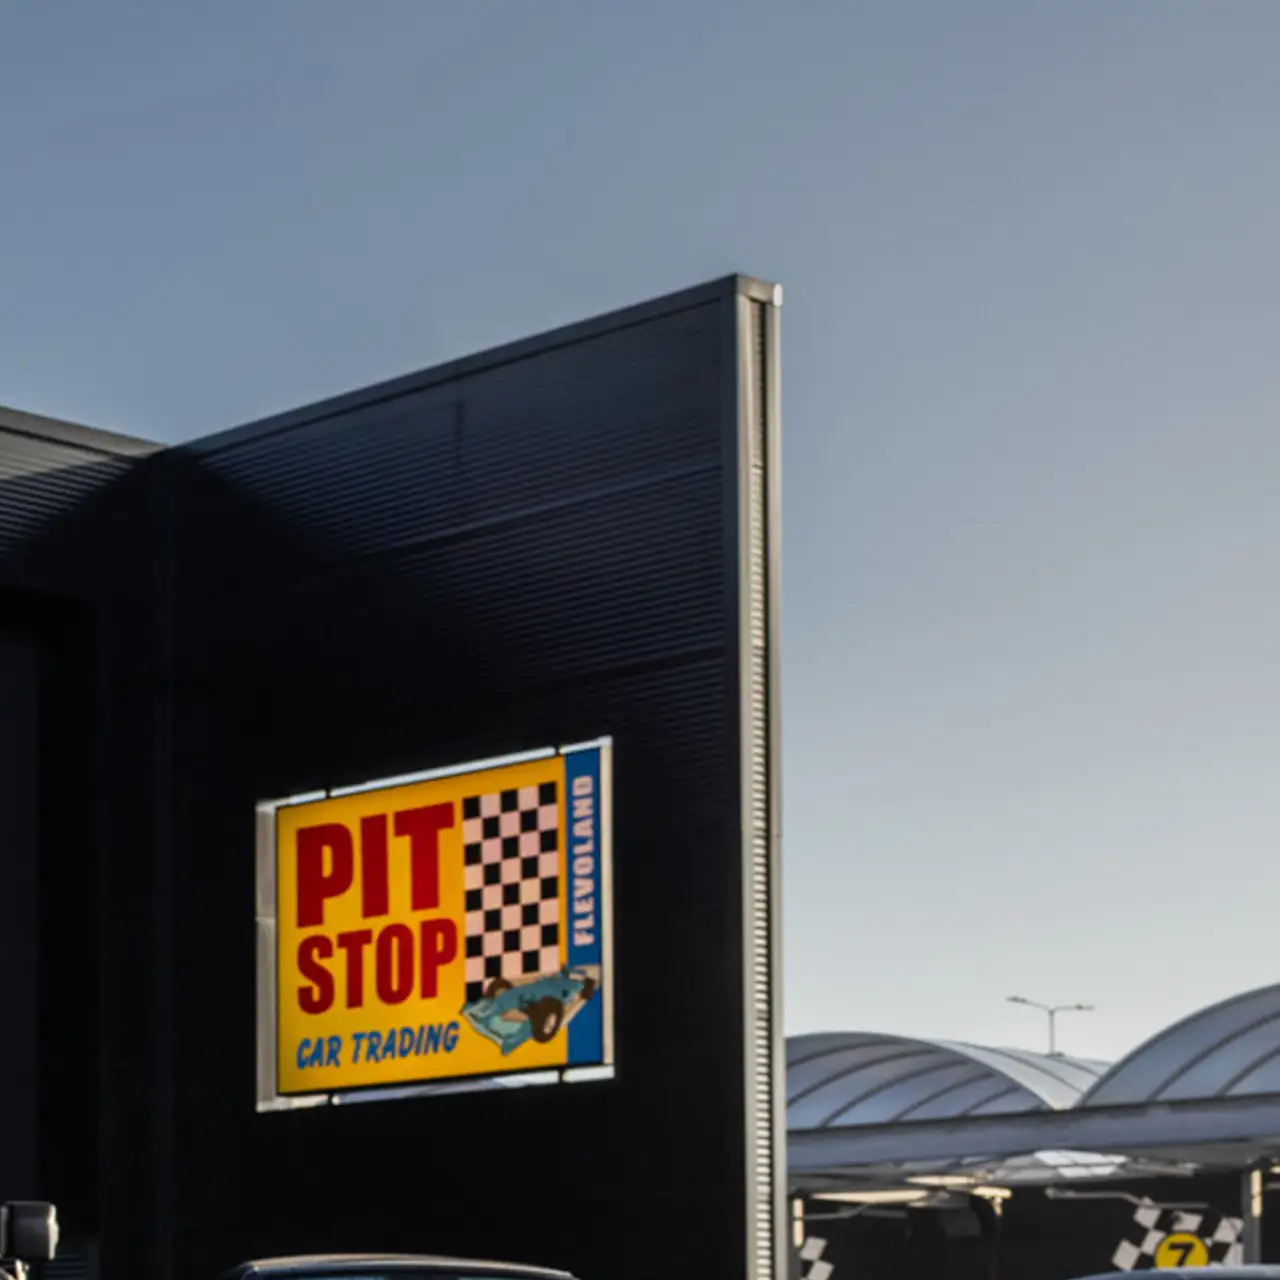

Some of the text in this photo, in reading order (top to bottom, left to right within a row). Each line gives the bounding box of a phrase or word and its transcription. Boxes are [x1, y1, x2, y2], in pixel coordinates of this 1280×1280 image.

[296, 801, 455, 929] PIT
[572, 774, 595, 948] FLEVOLAND
[296, 917, 458, 1016] STOP
[296, 1020, 460, 1070] CAR TRADING
[1167, 1241, 1197, 1268] 7
